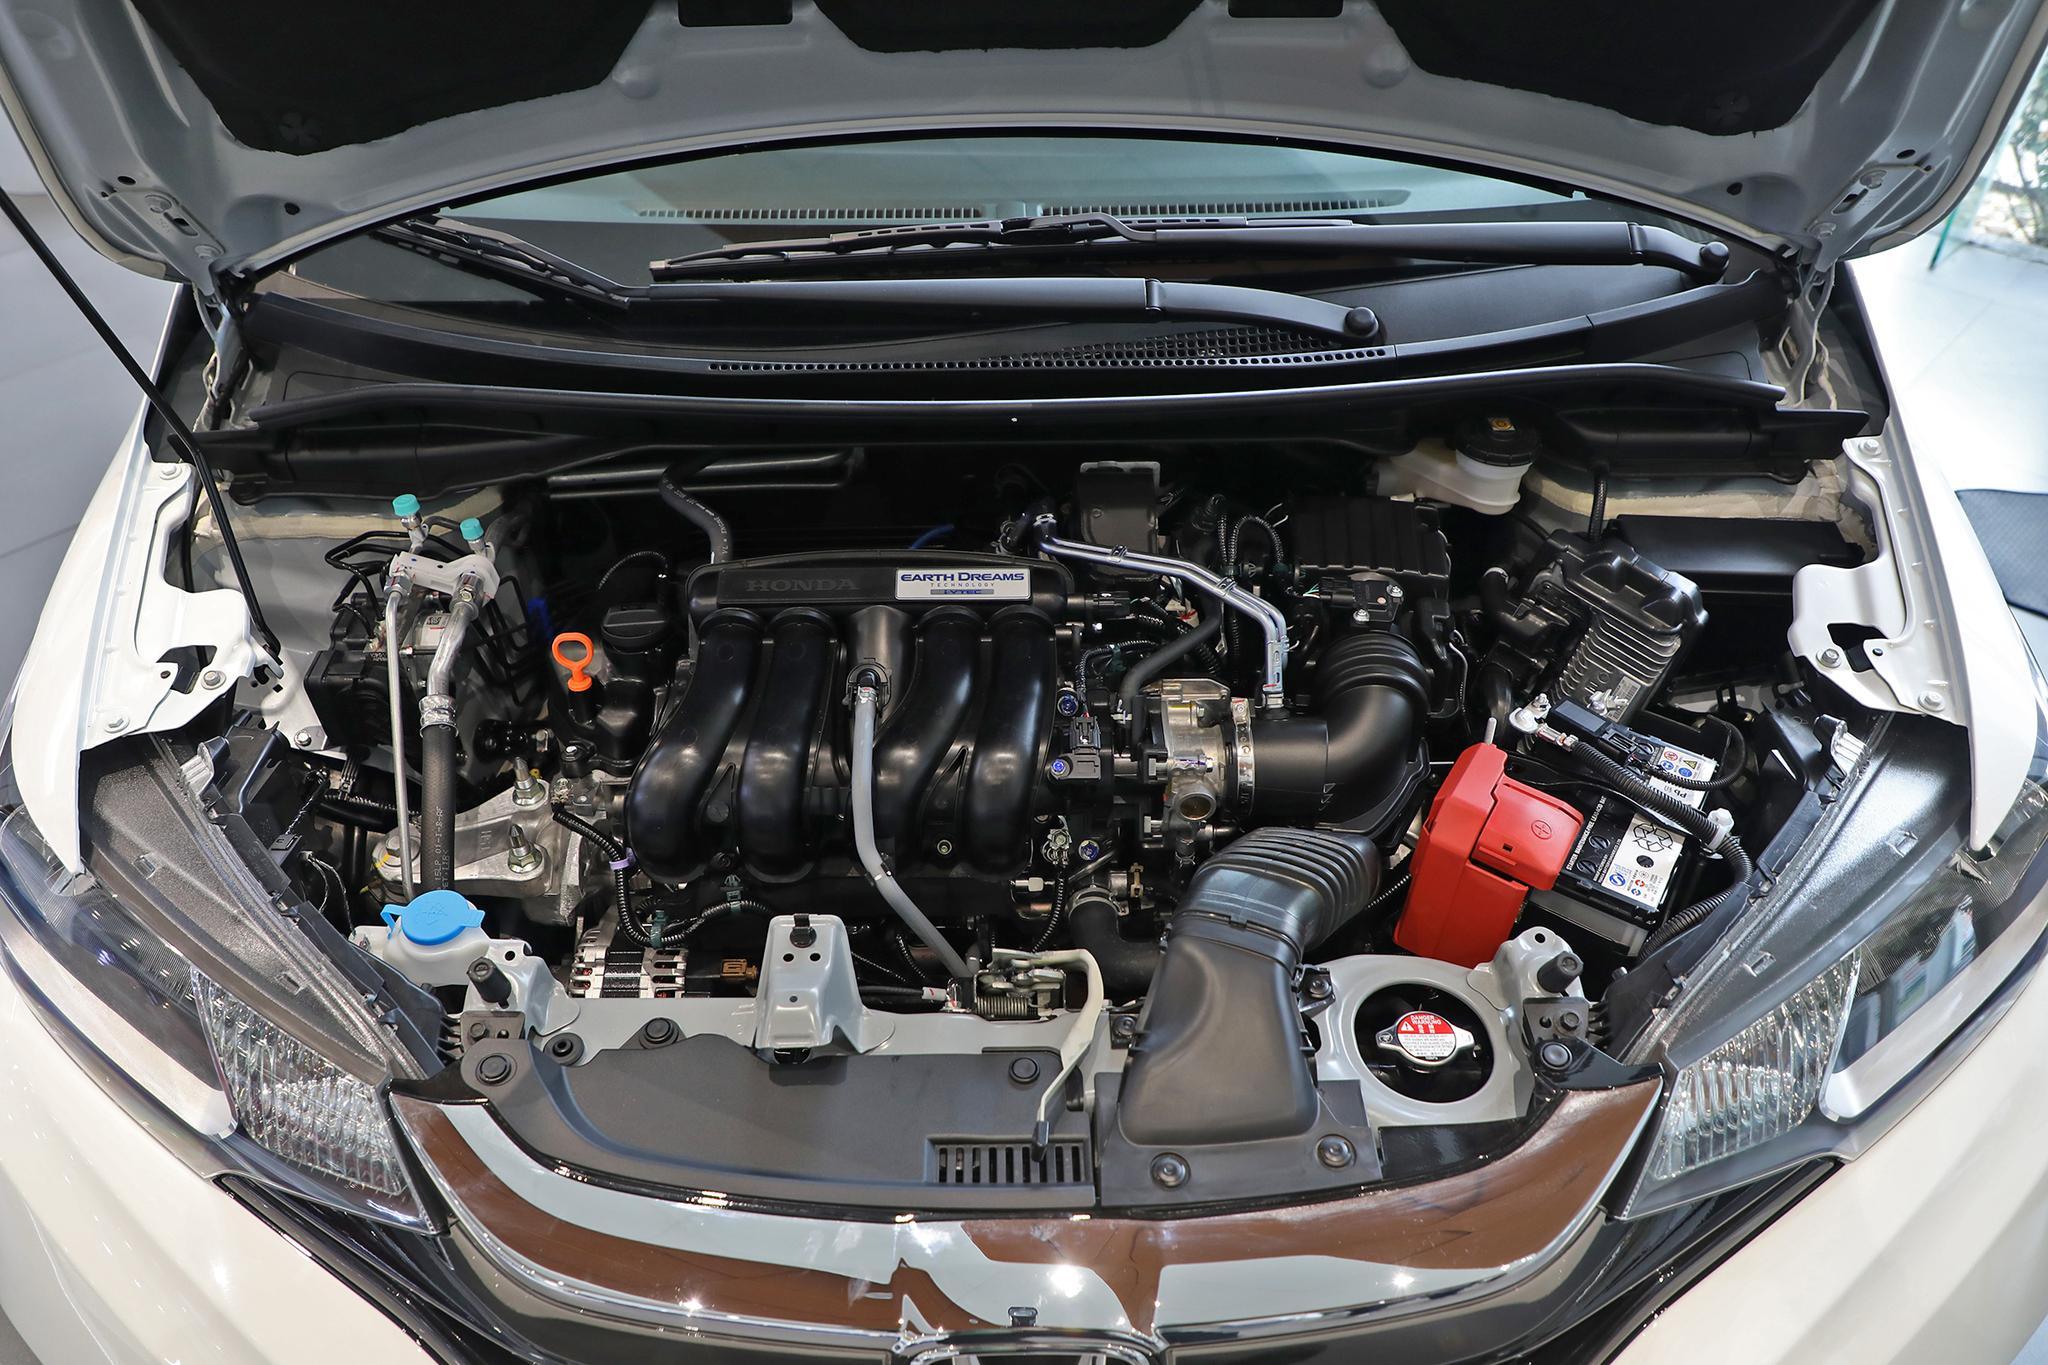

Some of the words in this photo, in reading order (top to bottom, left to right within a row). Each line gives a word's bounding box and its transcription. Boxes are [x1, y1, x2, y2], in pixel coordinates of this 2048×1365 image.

[900, 573, 954, 582] EARTH
[958, 572, 1025, 581] DREAMS
[745, 579, 860, 592] HONDA
